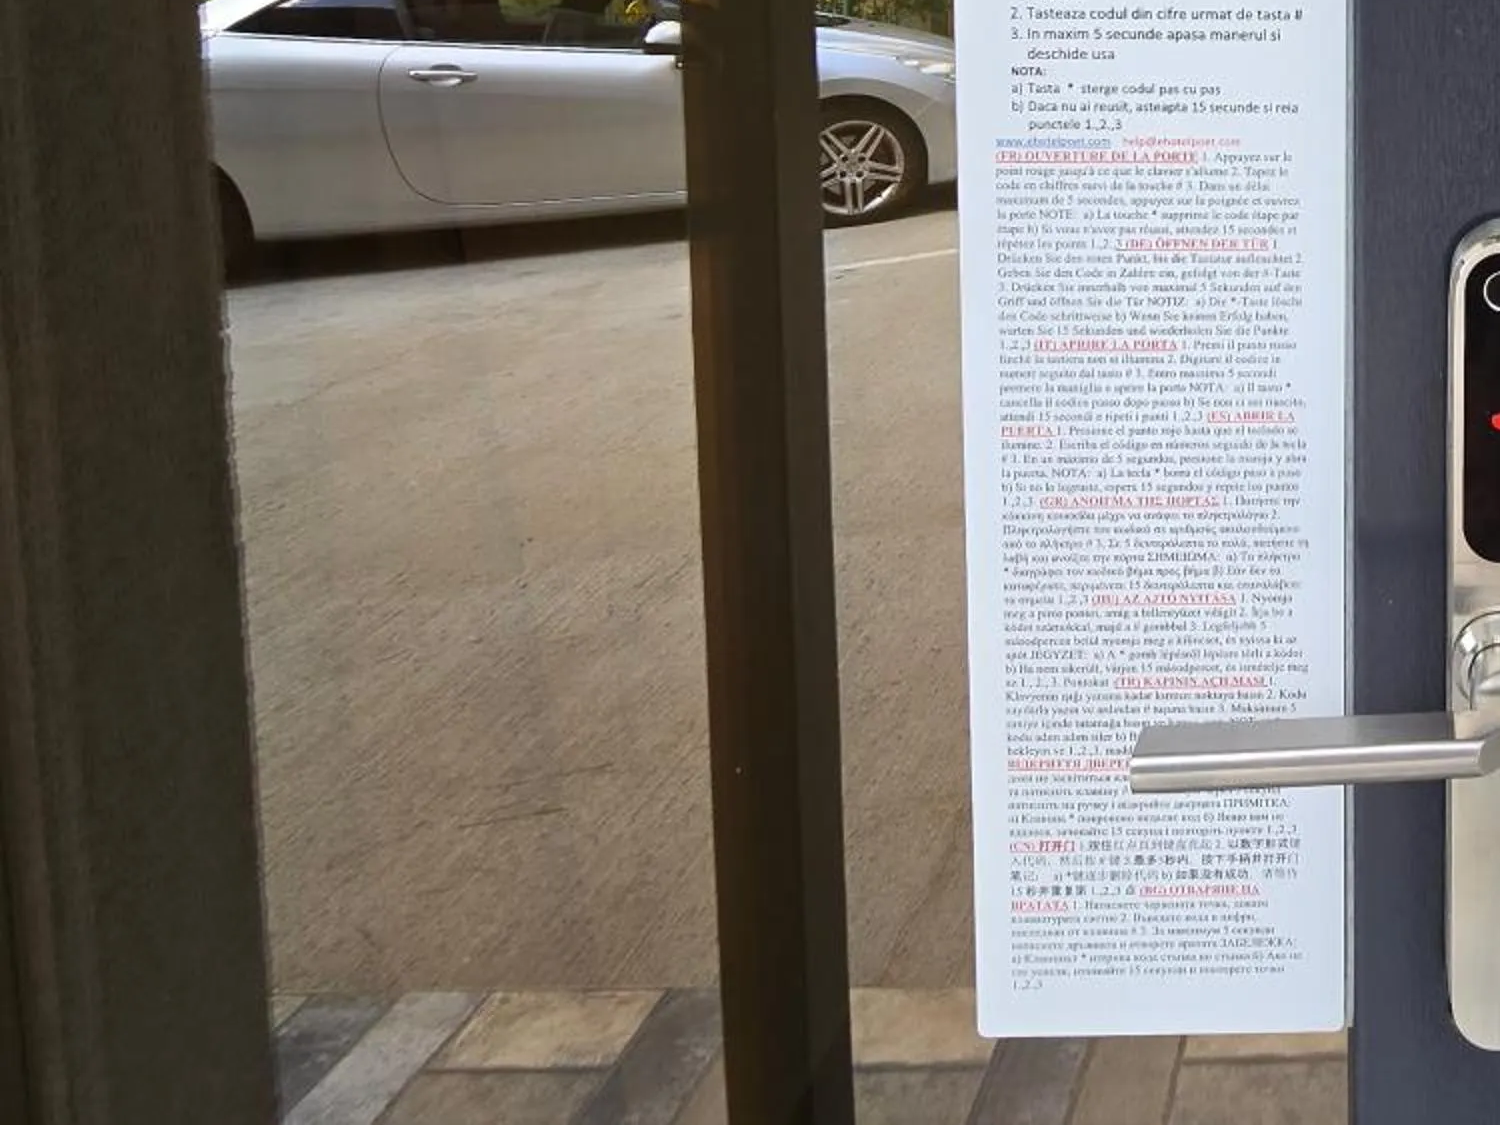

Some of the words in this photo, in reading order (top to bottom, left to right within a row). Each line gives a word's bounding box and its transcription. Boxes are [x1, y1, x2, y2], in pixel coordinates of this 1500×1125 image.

[1010, 7, 1022, 20] 2.
[1026, 7, 1086, 20] Tasteaza
[1089, 7, 1127, 20] codul
[1131, 7, 1153, 20] din
[1156, 7, 1187, 20] cifre
[1236, 7, 1253, 20] de
[1257, 9, 1291, 20] tasta
[1295, 8, 1303, 20] #
[1010, 27, 1023, 40] 3.
[1028, 27, 1041, 40] In
[1043, 27, 1089, 40] maxim
[1093, 27, 1102, 40] 5
[1105, 28, 1164, 40] secunde
[1167, 30, 1206, 43] apasa
[1210, 28, 1267, 41] manerul
[1270, 29, 1281, 41] si
[1028, 47, 1088, 60] deschide
[1091, 50, 1115, 60] usa
[1011, 83, 1023, 96] a)
[1028, 83, 1061, 94] Tasta
[1081, 83, 1118, 97] sterge
[1121, 83, 1155, 94] codul
[1159, 85, 1180, 97] pas
[1183, 85, 1197, 95] cu
[1200, 85, 1221, 97] pas
[1011, 100, 1024, 114] b)
[1028, 101, 1058, 112] Daca
[1061, 103, 1077, 112] nu
[1080, 101, 1091, 112] ai
[1093, 101, 1133, 114] reusit,
[1136, 102, 1189, 115] asteapta
[1192, 101, 1207, 113] 15
[1209, 101, 1260, 114] secunde
[1263, 102, 1273, 113] si
[1275, 102, 1299, 114] reia
[1028, 119, 1081, 132] punctele
